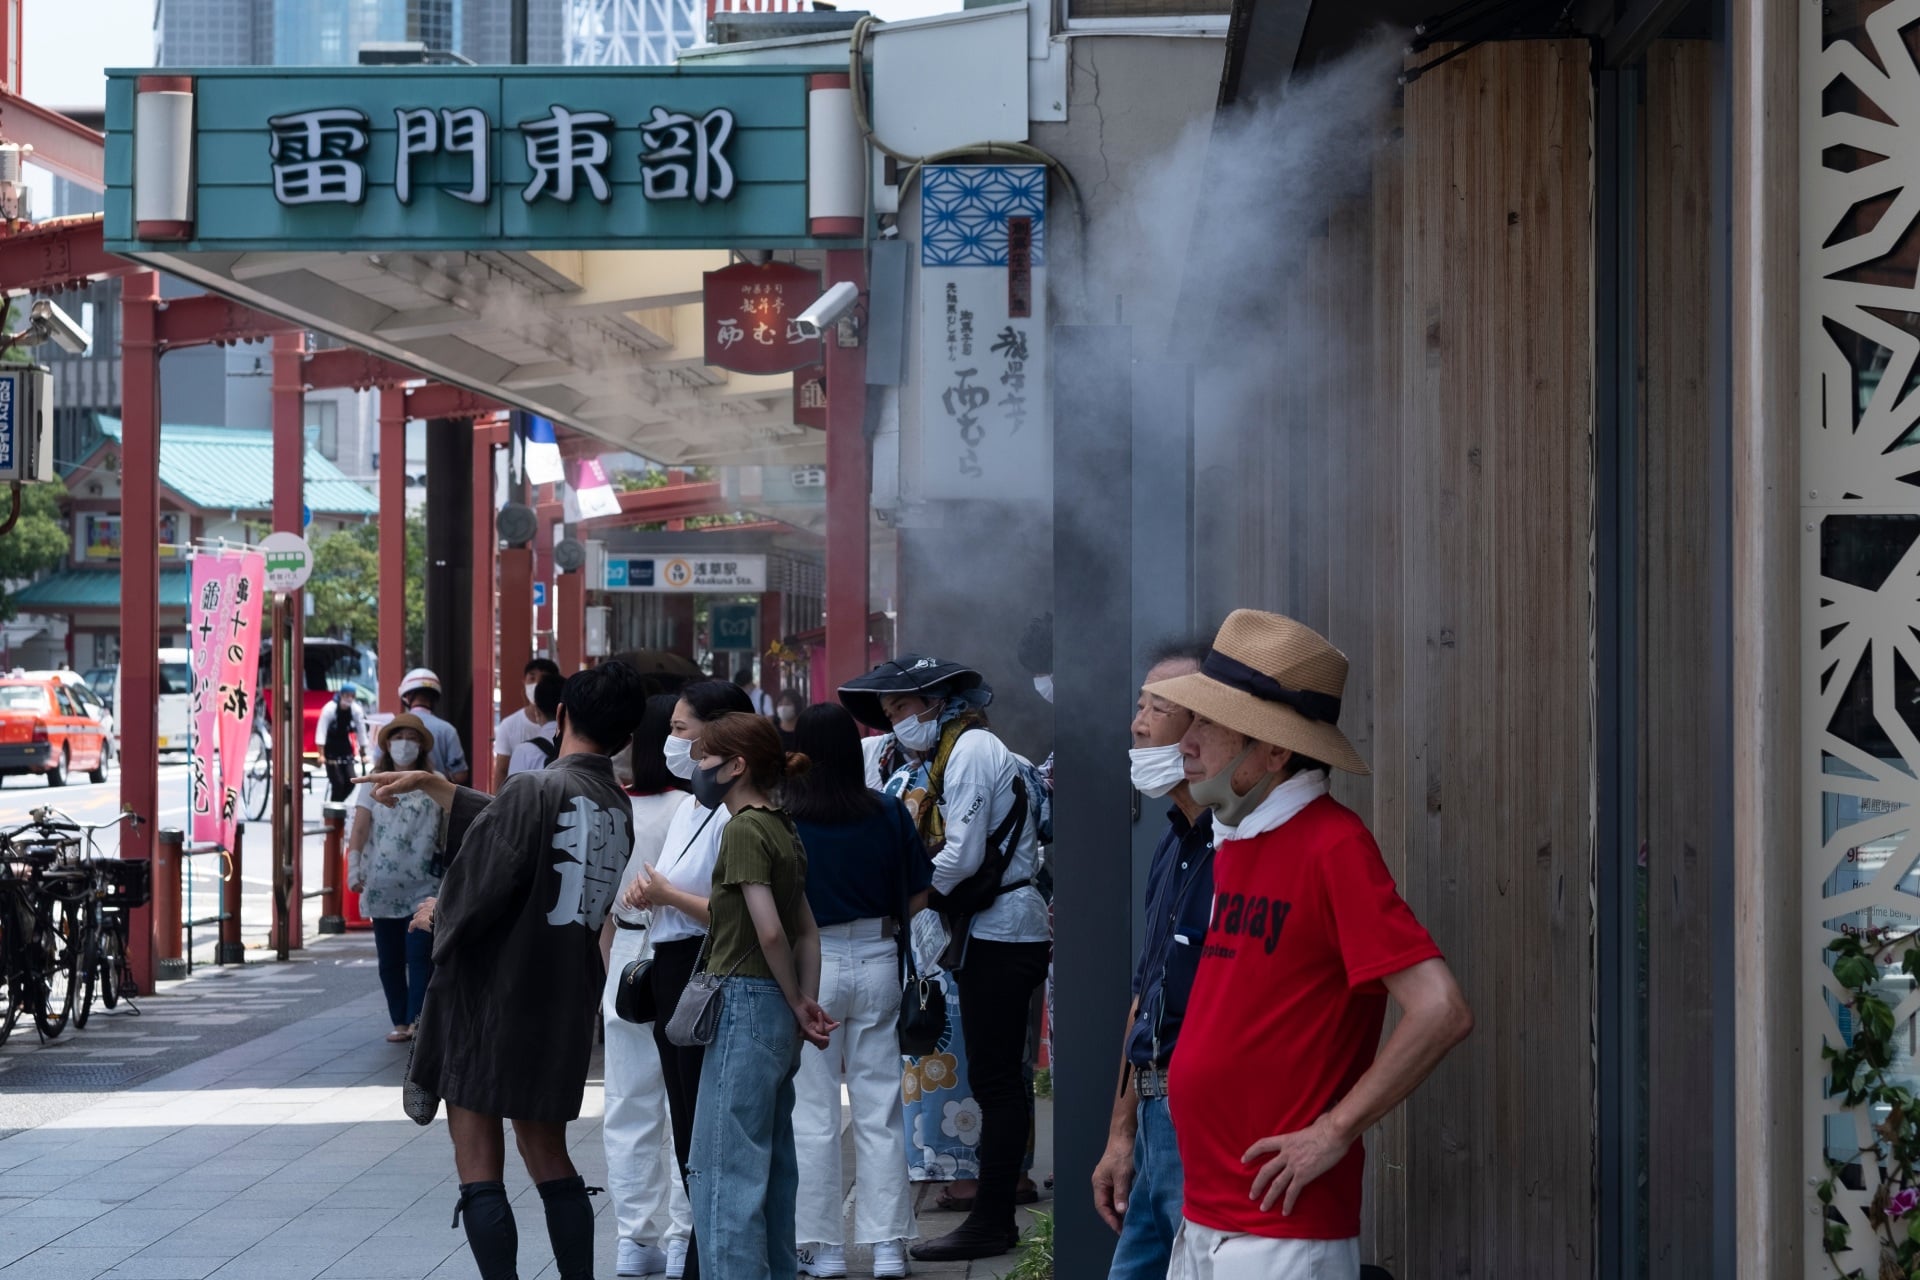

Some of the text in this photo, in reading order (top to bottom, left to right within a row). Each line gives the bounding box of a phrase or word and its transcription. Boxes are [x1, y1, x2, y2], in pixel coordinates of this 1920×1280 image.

[268, 104, 736, 206] 雷門東部
[941, 367, 990, 479] 西むら
[671, 571, 685, 581] 19
[693, 561, 738, 576] 浅草駅
[693, 576, 754, 586] Asakusa Sta.
